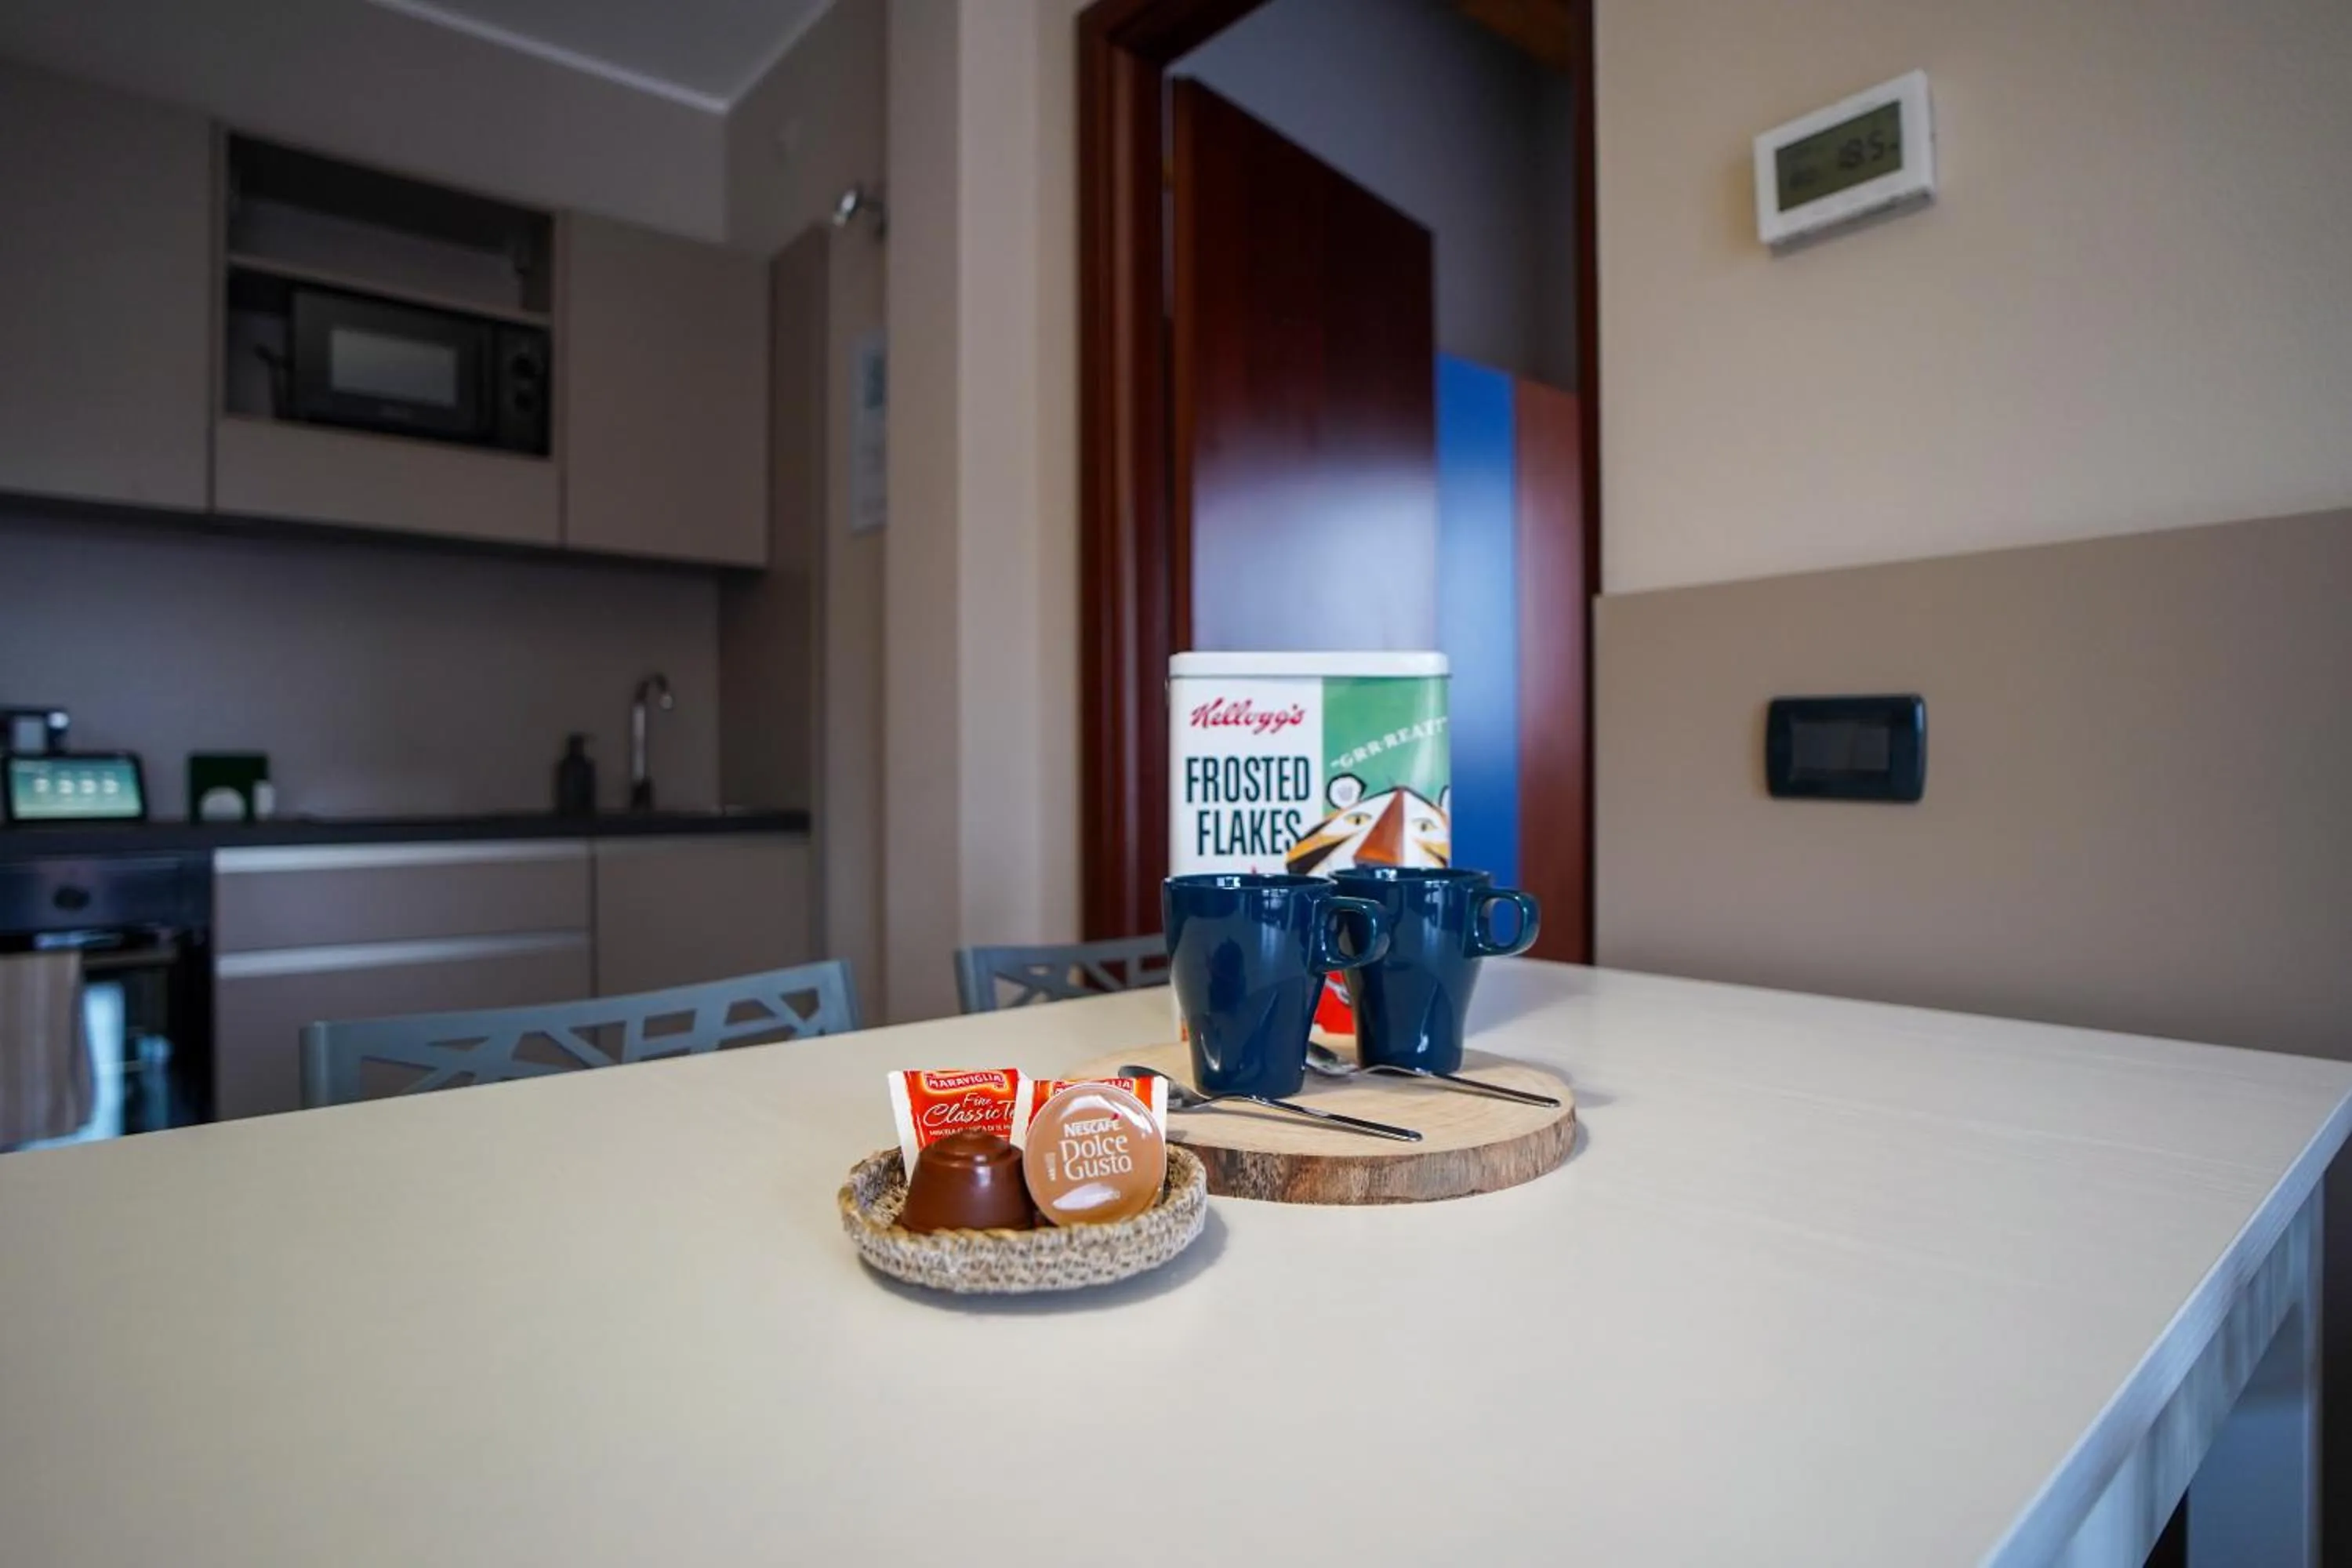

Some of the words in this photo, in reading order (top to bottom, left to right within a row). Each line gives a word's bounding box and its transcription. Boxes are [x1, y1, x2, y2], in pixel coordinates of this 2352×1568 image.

[1190, 697, 1305, 734] Kellogg's
[1185, 756, 1310, 803] FROSTED
[1197, 809, 1302, 856] FLAKES
[928, 1073, 1004, 1088] MARAVIGLIA
[924, 1103, 1001, 1127] Classic
[1059, 1134, 1129, 1162] Dolce
[1065, 1155, 1133, 1181] Gusto
